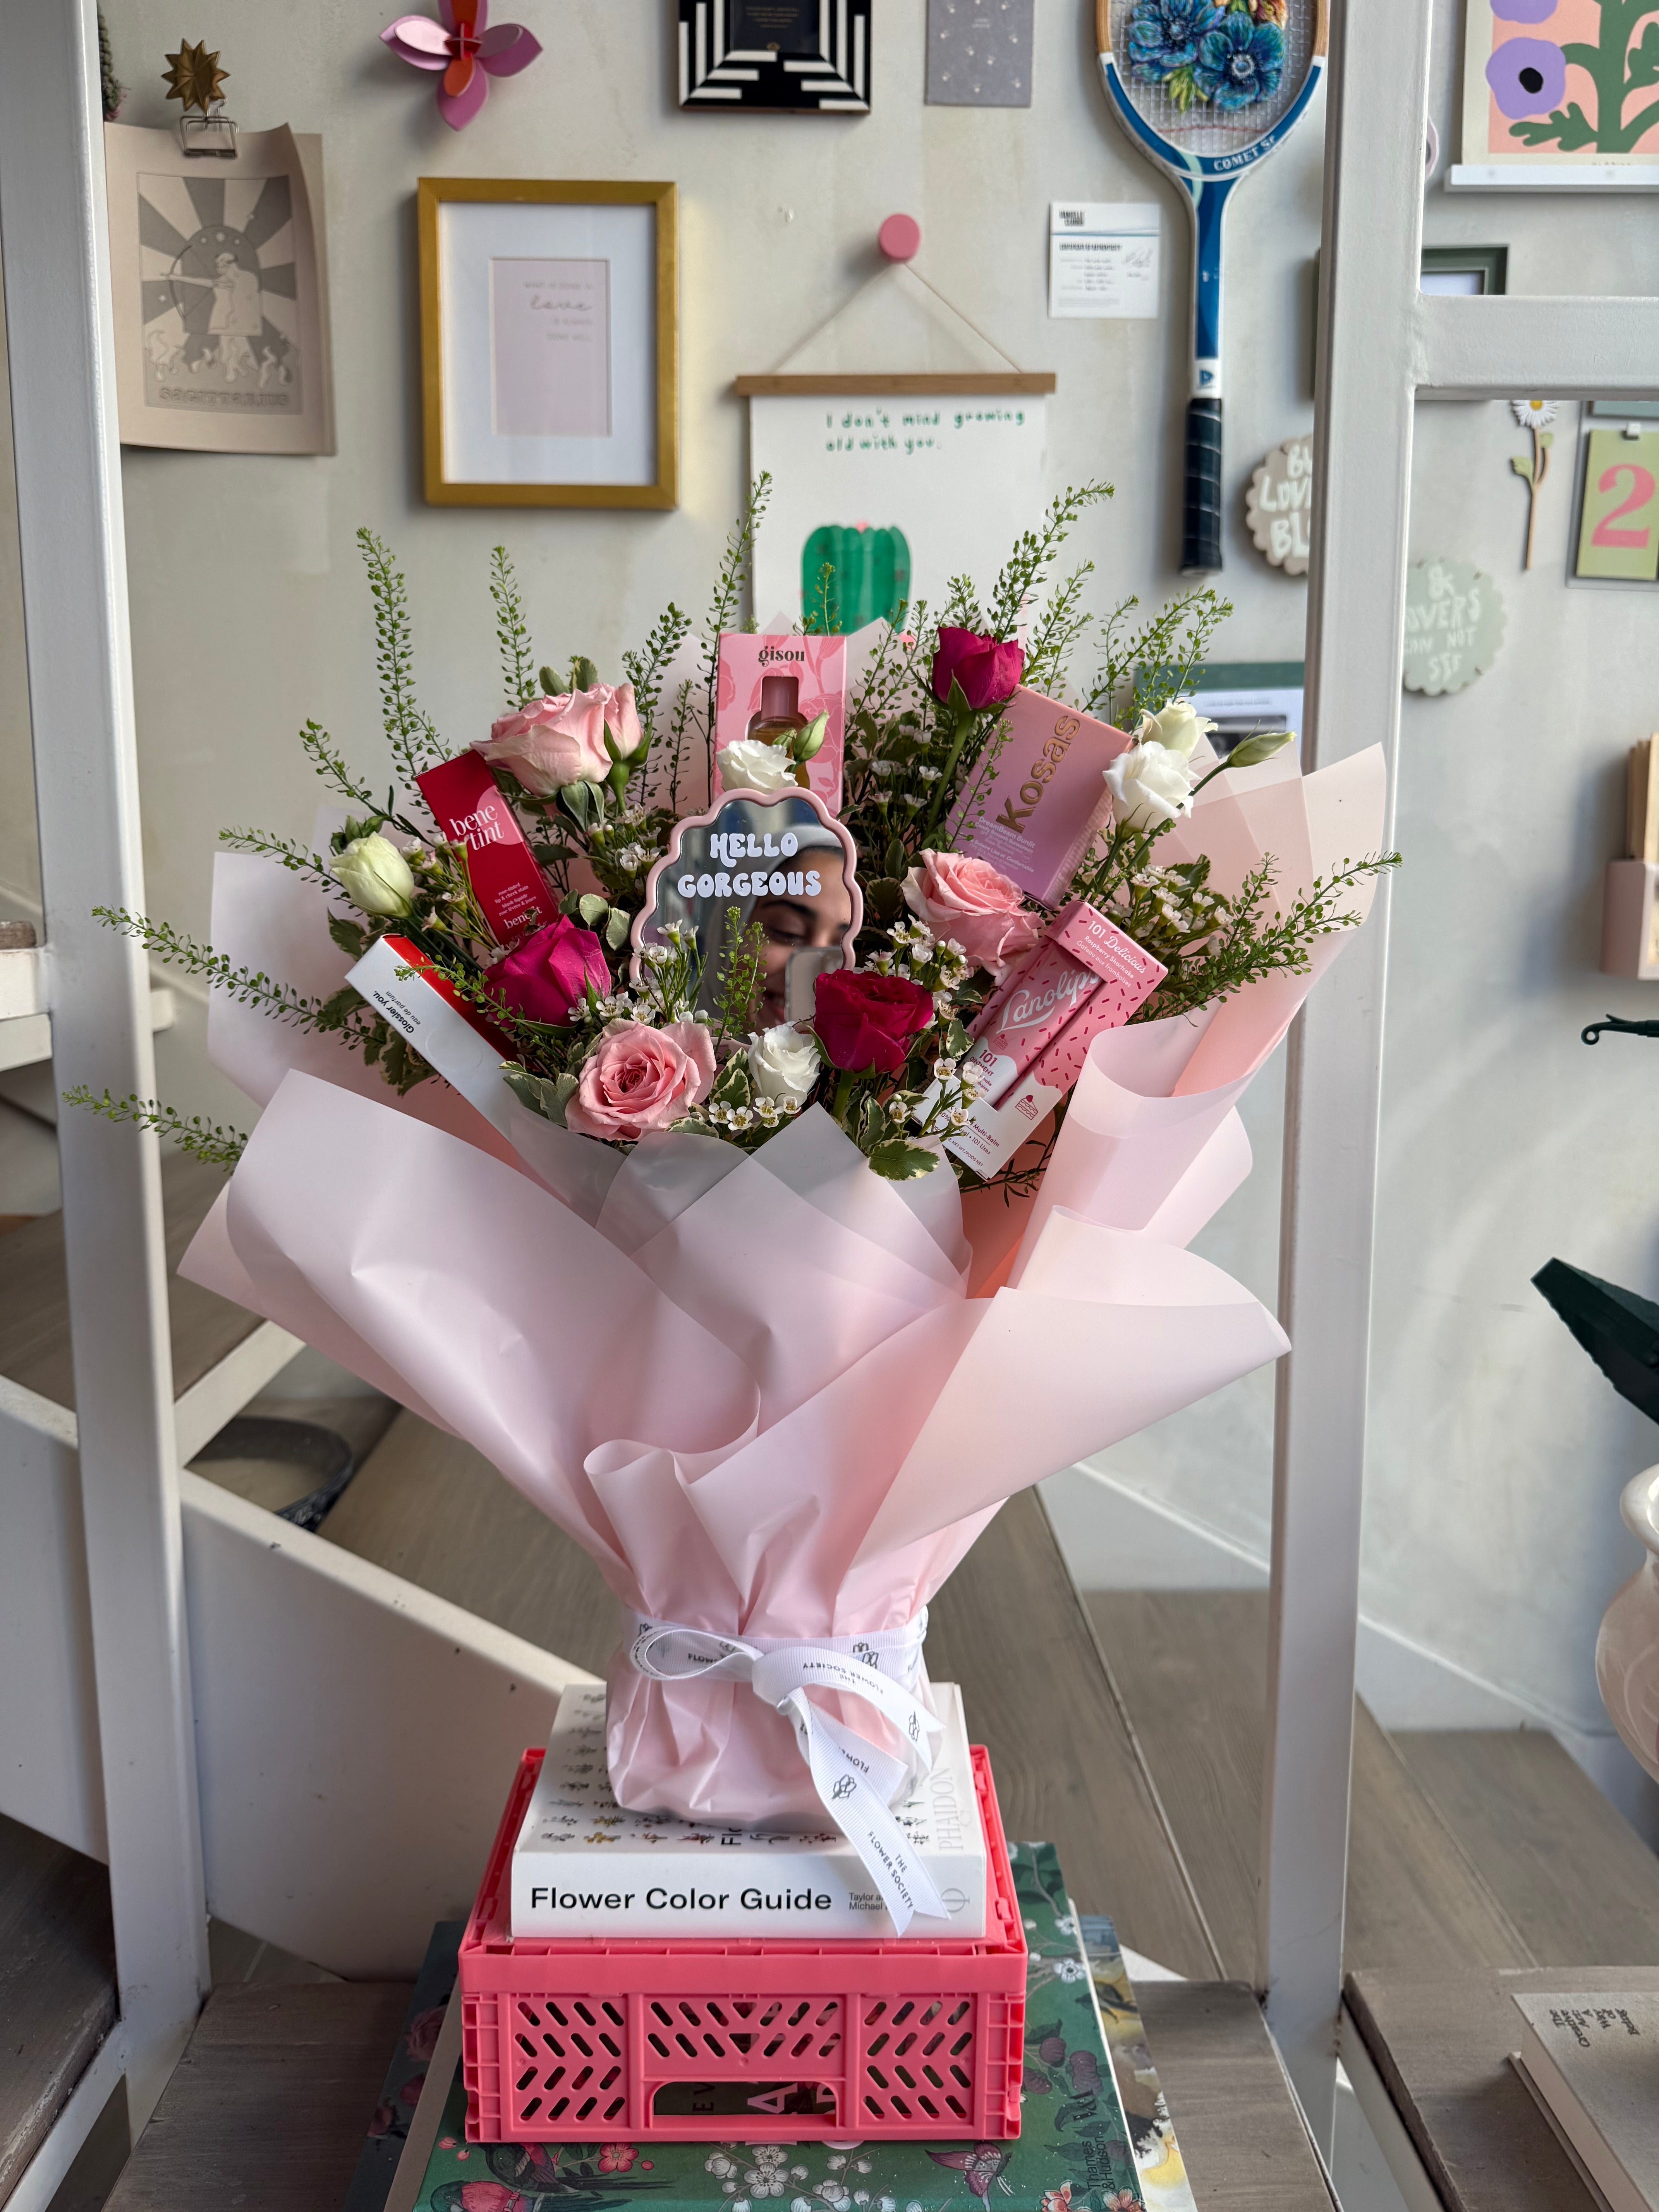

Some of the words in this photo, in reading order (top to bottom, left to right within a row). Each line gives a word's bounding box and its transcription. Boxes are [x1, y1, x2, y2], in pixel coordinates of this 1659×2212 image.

[1213, 147, 1259, 171] COMET
[826, 414, 833, 429] I
[841, 406, 890, 428] don't
[902, 411, 940, 426] mind
[954, 409, 1025, 429] growing
[826, 436, 854, 452] old
[859, 434, 898, 451] with
[1591, 463, 1656, 549] 2
[1405, 587, 1481, 632] OVERS
[758, 646, 805, 667] gisou
[995, 715, 1080, 834] Kosas
[449, 805, 498, 836] bene
[978, 816, 1017, 839] DreamBeam
[1017, 835, 1036, 848] Sunlit
[469, 821, 505, 851] tint
[975, 822, 991, 833] Comfy
[990, 830, 1008, 842] Smooth
[1008, 838, 1033, 854] Sunscreen
[709, 832, 798, 868] HELLO
[974, 839, 990, 851] Solaire
[1006, 856, 1034, 873] Confortable
[677, 870, 822, 898] GORGEOUS
[1084, 935, 1110, 959] Raspberry
[1109, 956, 1134, 979] Shortcake
[1088, 920, 1106, 939] 101
[1103, 936, 1146, 974] Delicious
[1095, 957, 1105, 966] aux
[1105, 963, 1131, 988] framboises
[373, 991, 390, 1006] you.
[386, 991, 406, 1009] parfum
[385, 1006, 414, 1033] Glossier
[410, 1015, 421, 1025] eau
[979, 1049, 998, 1067] 101
[972, 1137, 980, 1146] 101
[980, 1144, 991, 1155] Uses
[973, 1124, 1000, 1147] Multi-Balm
[802, 1662, 847, 1674] SOCIETY
[850, 1671, 883, 1694] FLOWER
[929, 1768, 964, 1850] PHAIDON
[867, 1831, 893, 1870] FLOWER
[891, 1869, 914, 1908] SOCIETY
[895, 1853, 908, 1873] THE
[531, 1887, 635, 1909] Flower
[646, 1887, 730, 1910] Color
[740, 1887, 832, 1910] Guide
[848, 1892, 874, 1903] Taylor
[849, 1901, 883, 1910] Michael
[1082, 2140, 1101, 2192] Thames
